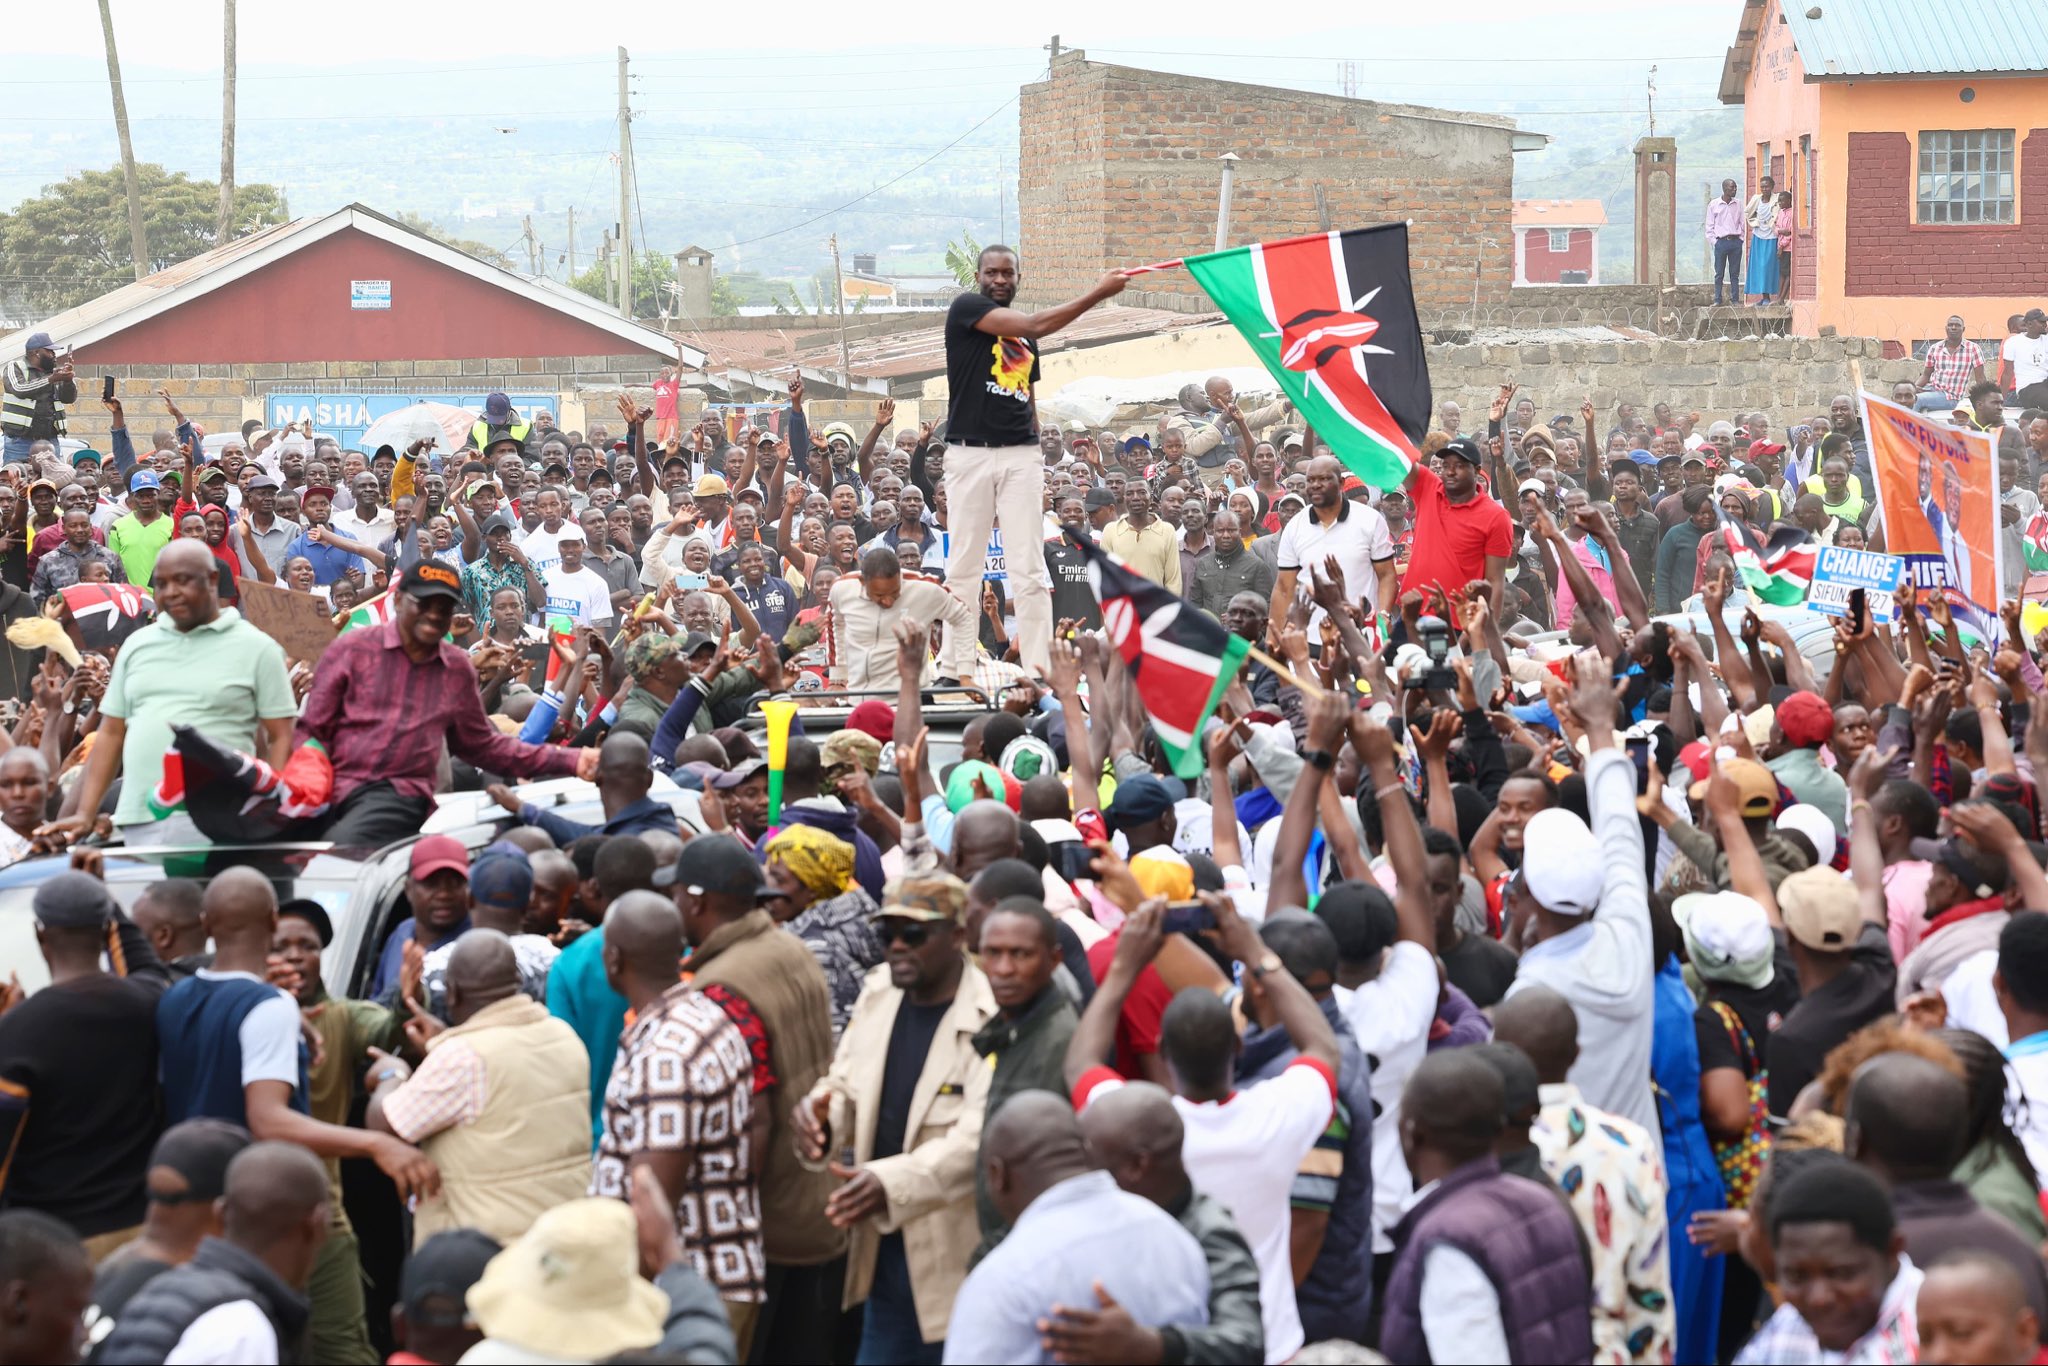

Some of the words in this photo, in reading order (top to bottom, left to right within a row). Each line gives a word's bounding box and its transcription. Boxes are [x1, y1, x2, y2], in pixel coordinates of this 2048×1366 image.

[986, 381, 1012, 396] TOLD
[276, 404, 373, 426] NASHA
[1058, 564, 1087, 575] Emira
[1822, 548, 1897, 582] CHANGE
[1815, 583, 1850, 603] SIFUN
[546, 597, 578, 611] LINDA
